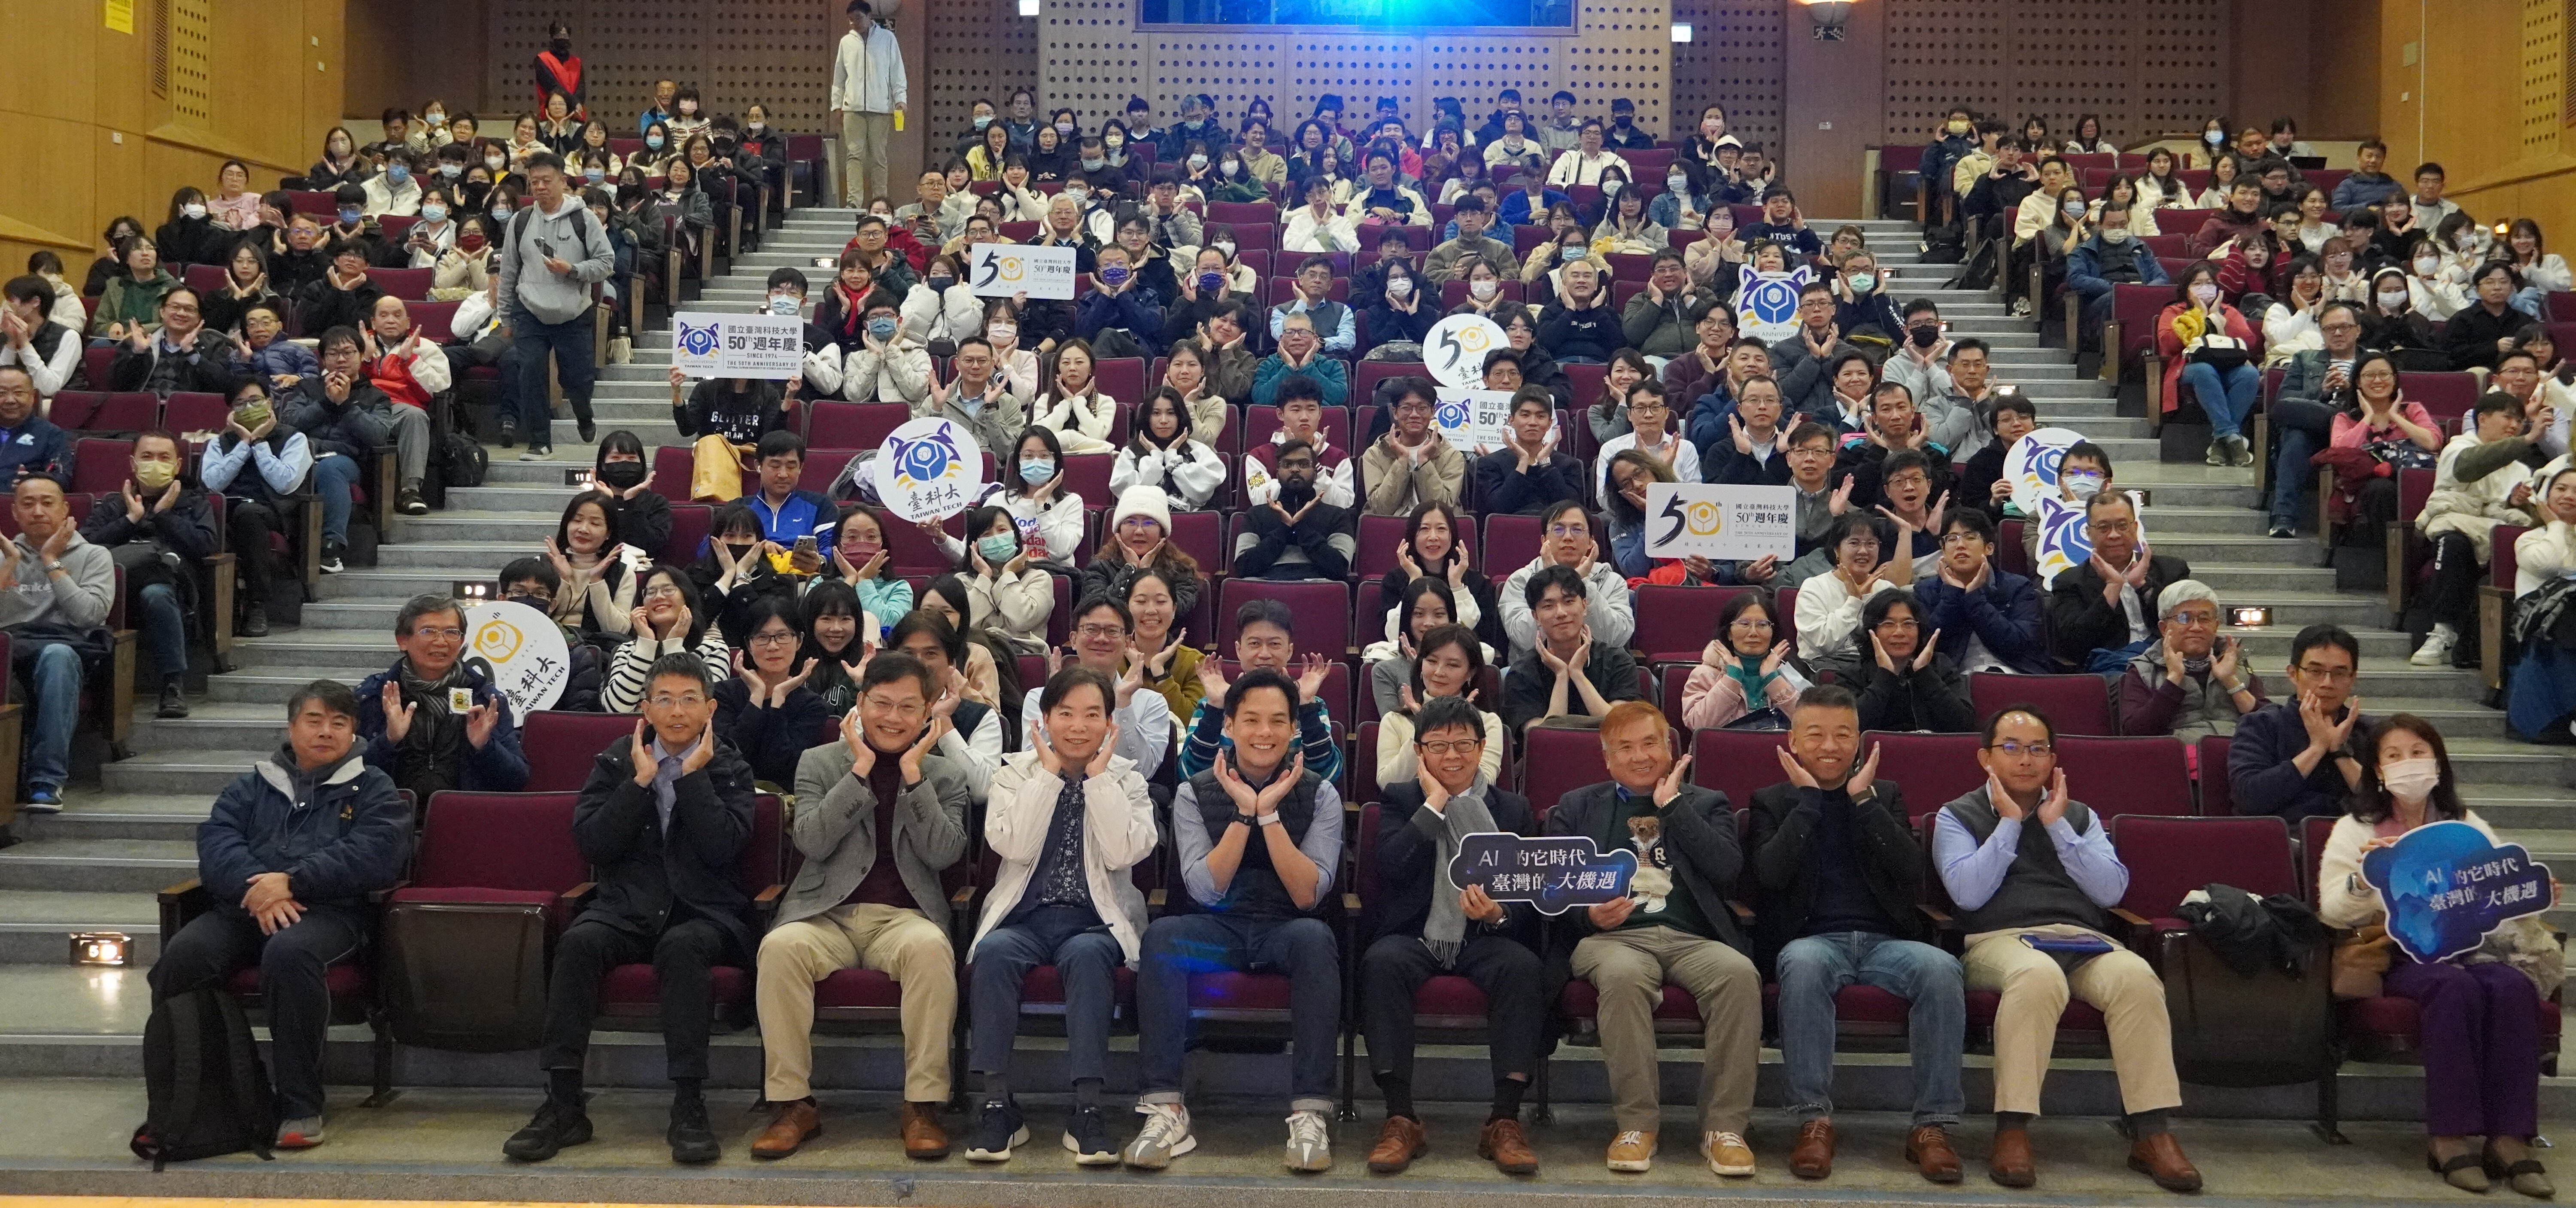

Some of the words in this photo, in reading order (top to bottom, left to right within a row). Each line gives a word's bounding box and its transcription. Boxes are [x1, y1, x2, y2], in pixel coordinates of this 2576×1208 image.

[728, 325, 797, 335] 國立臺灣科技大學
[728, 335, 797, 351] 50th週年慶
[908, 484, 960, 512] 臺科大
[910, 508, 940, 520] TAIWAN
[942, 502, 962, 511] TECH
[1735, 512, 1789, 524] 50th週年慶
[505, 657, 557, 707] 臺科大
[547, 666, 565, 685] TECH
[1478, 850, 1499, 866] AI
[1654, 847, 1667, 861] R
[1554, 871, 1617, 890] 大機遇
[2426, 867, 2442, 885] AI
[2484, 880, 2538, 909] 大機遇
